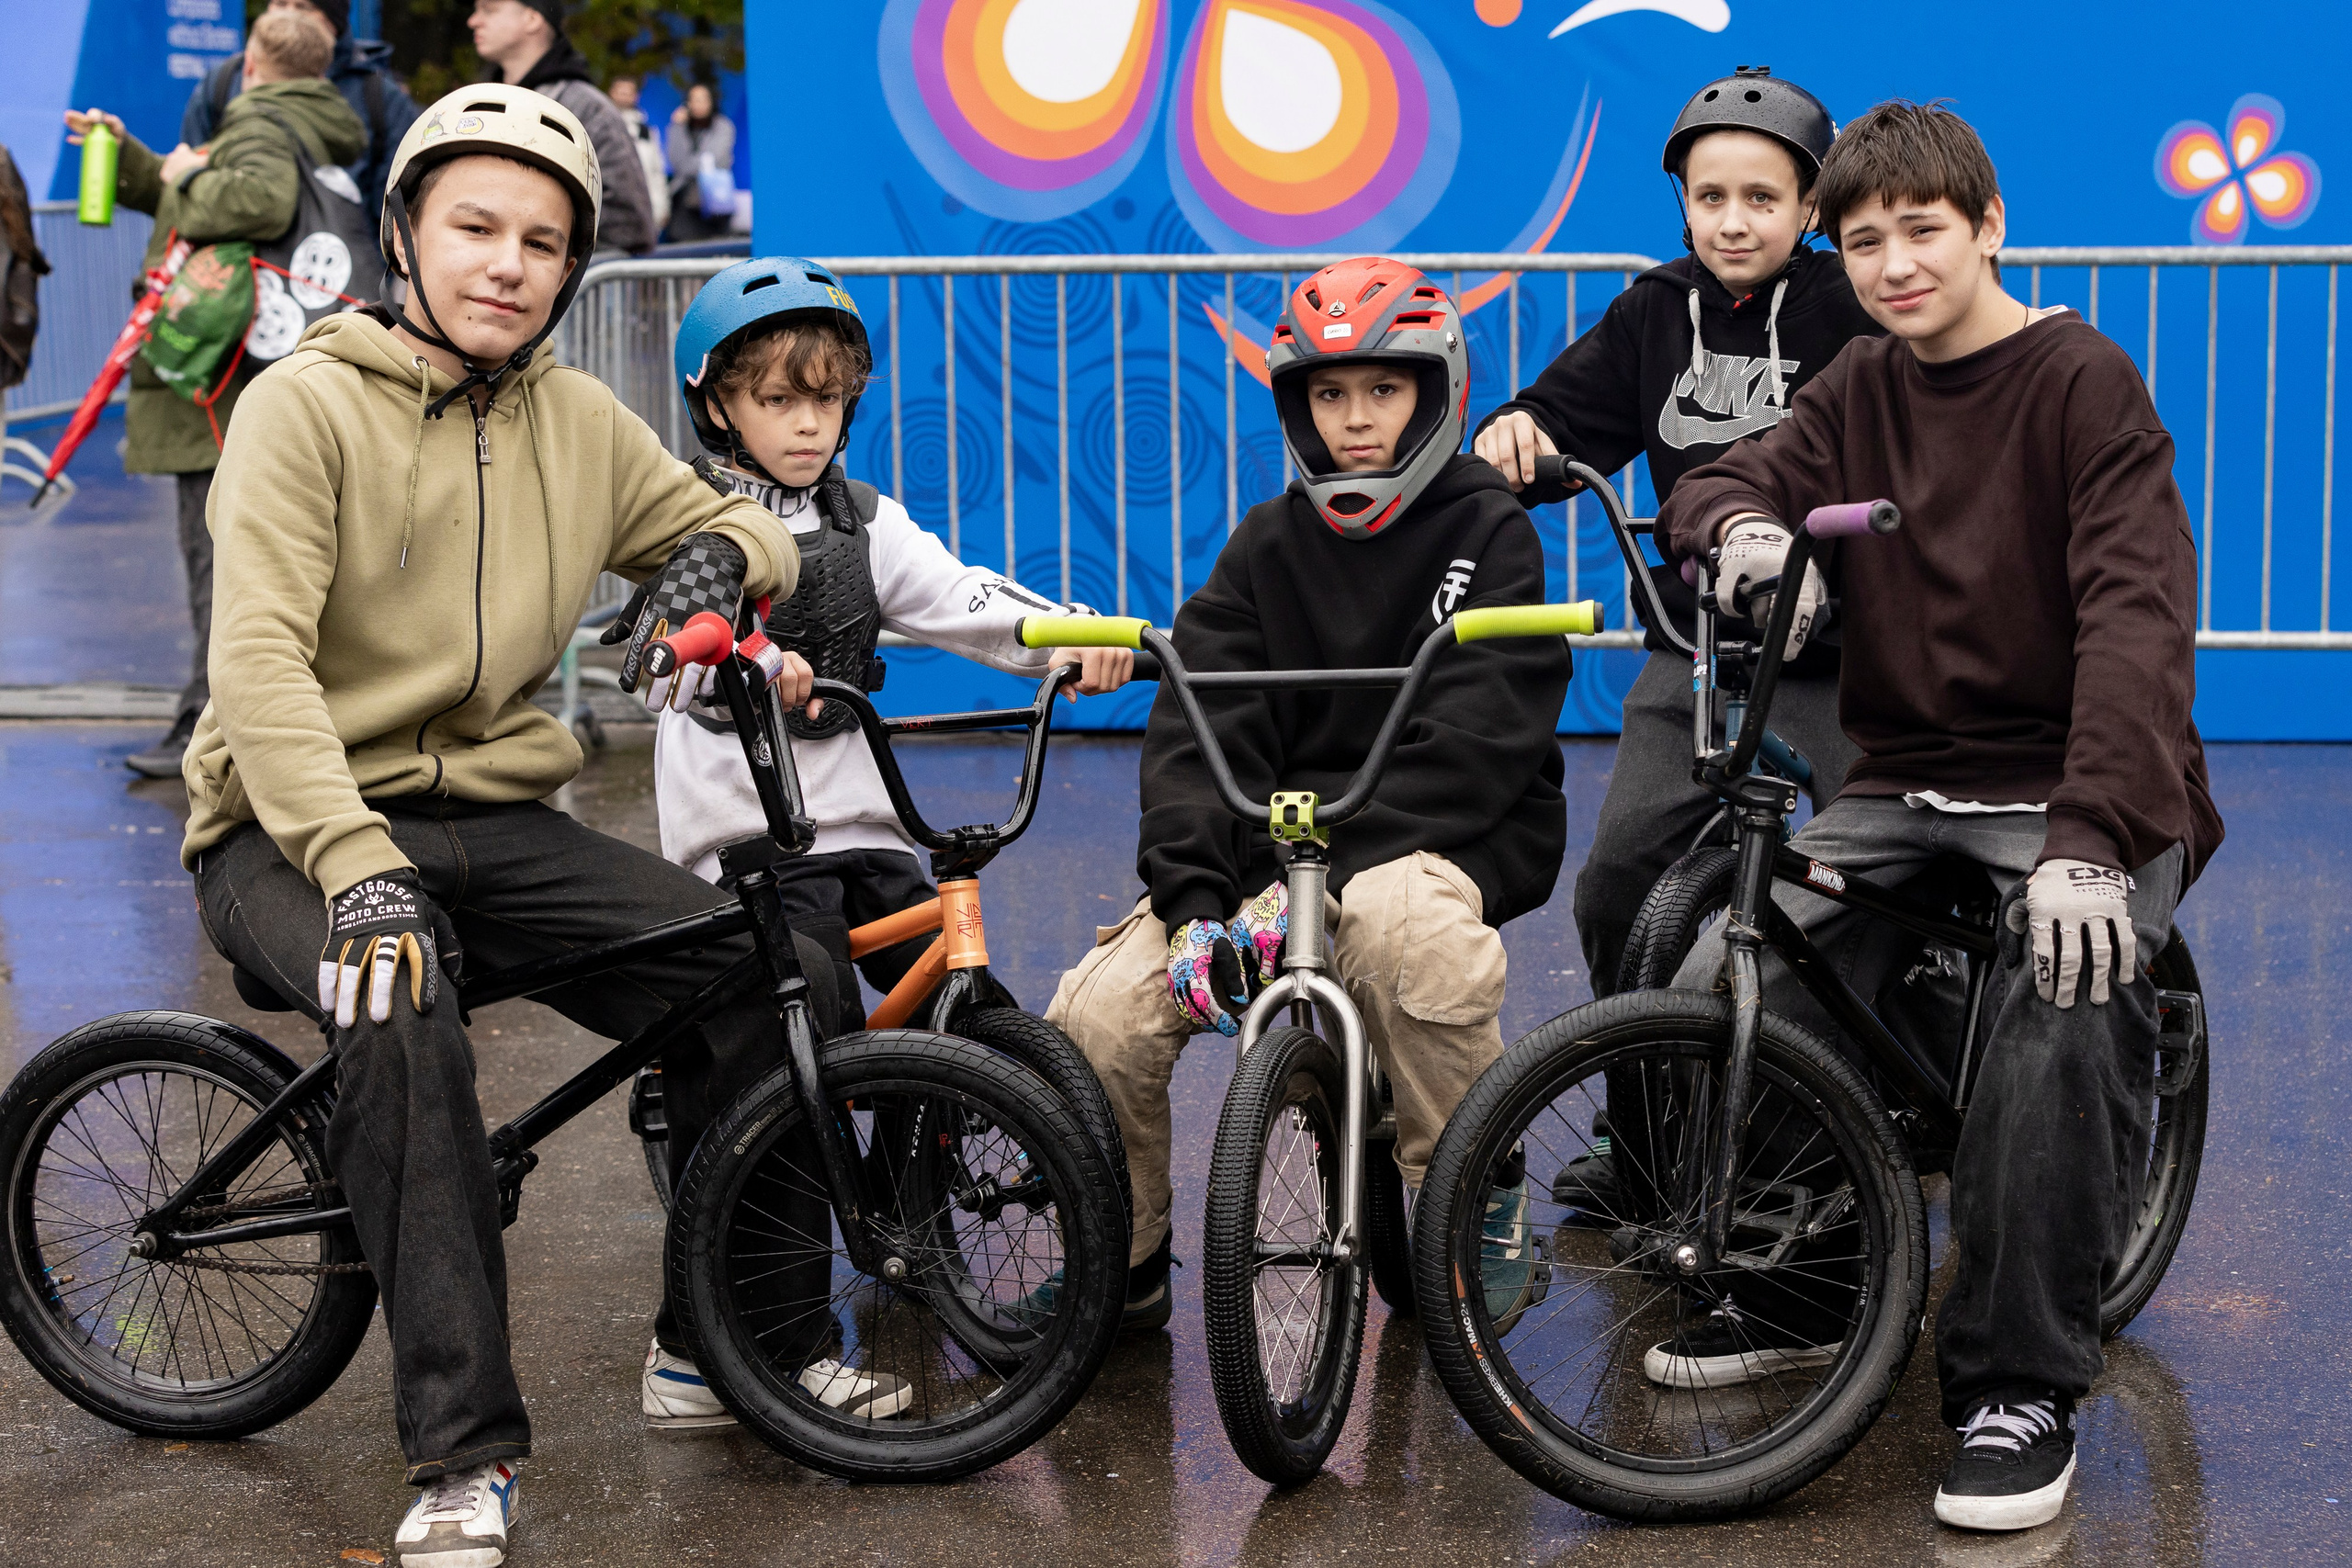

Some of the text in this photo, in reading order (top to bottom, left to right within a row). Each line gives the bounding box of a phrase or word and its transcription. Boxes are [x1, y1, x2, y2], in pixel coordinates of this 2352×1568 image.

[1676, 349, 1801, 417] NIKE
[622, 609, 655, 682] FASTGOOSE
[899, 716, 934, 729] VERT
[337, 880, 413, 912] FASTGOOSE
[337, 904, 416, 924] MOTO CREW
[739, 1121, 763, 1145] TRACER
[303, 1141, 321, 1168] TRACER
